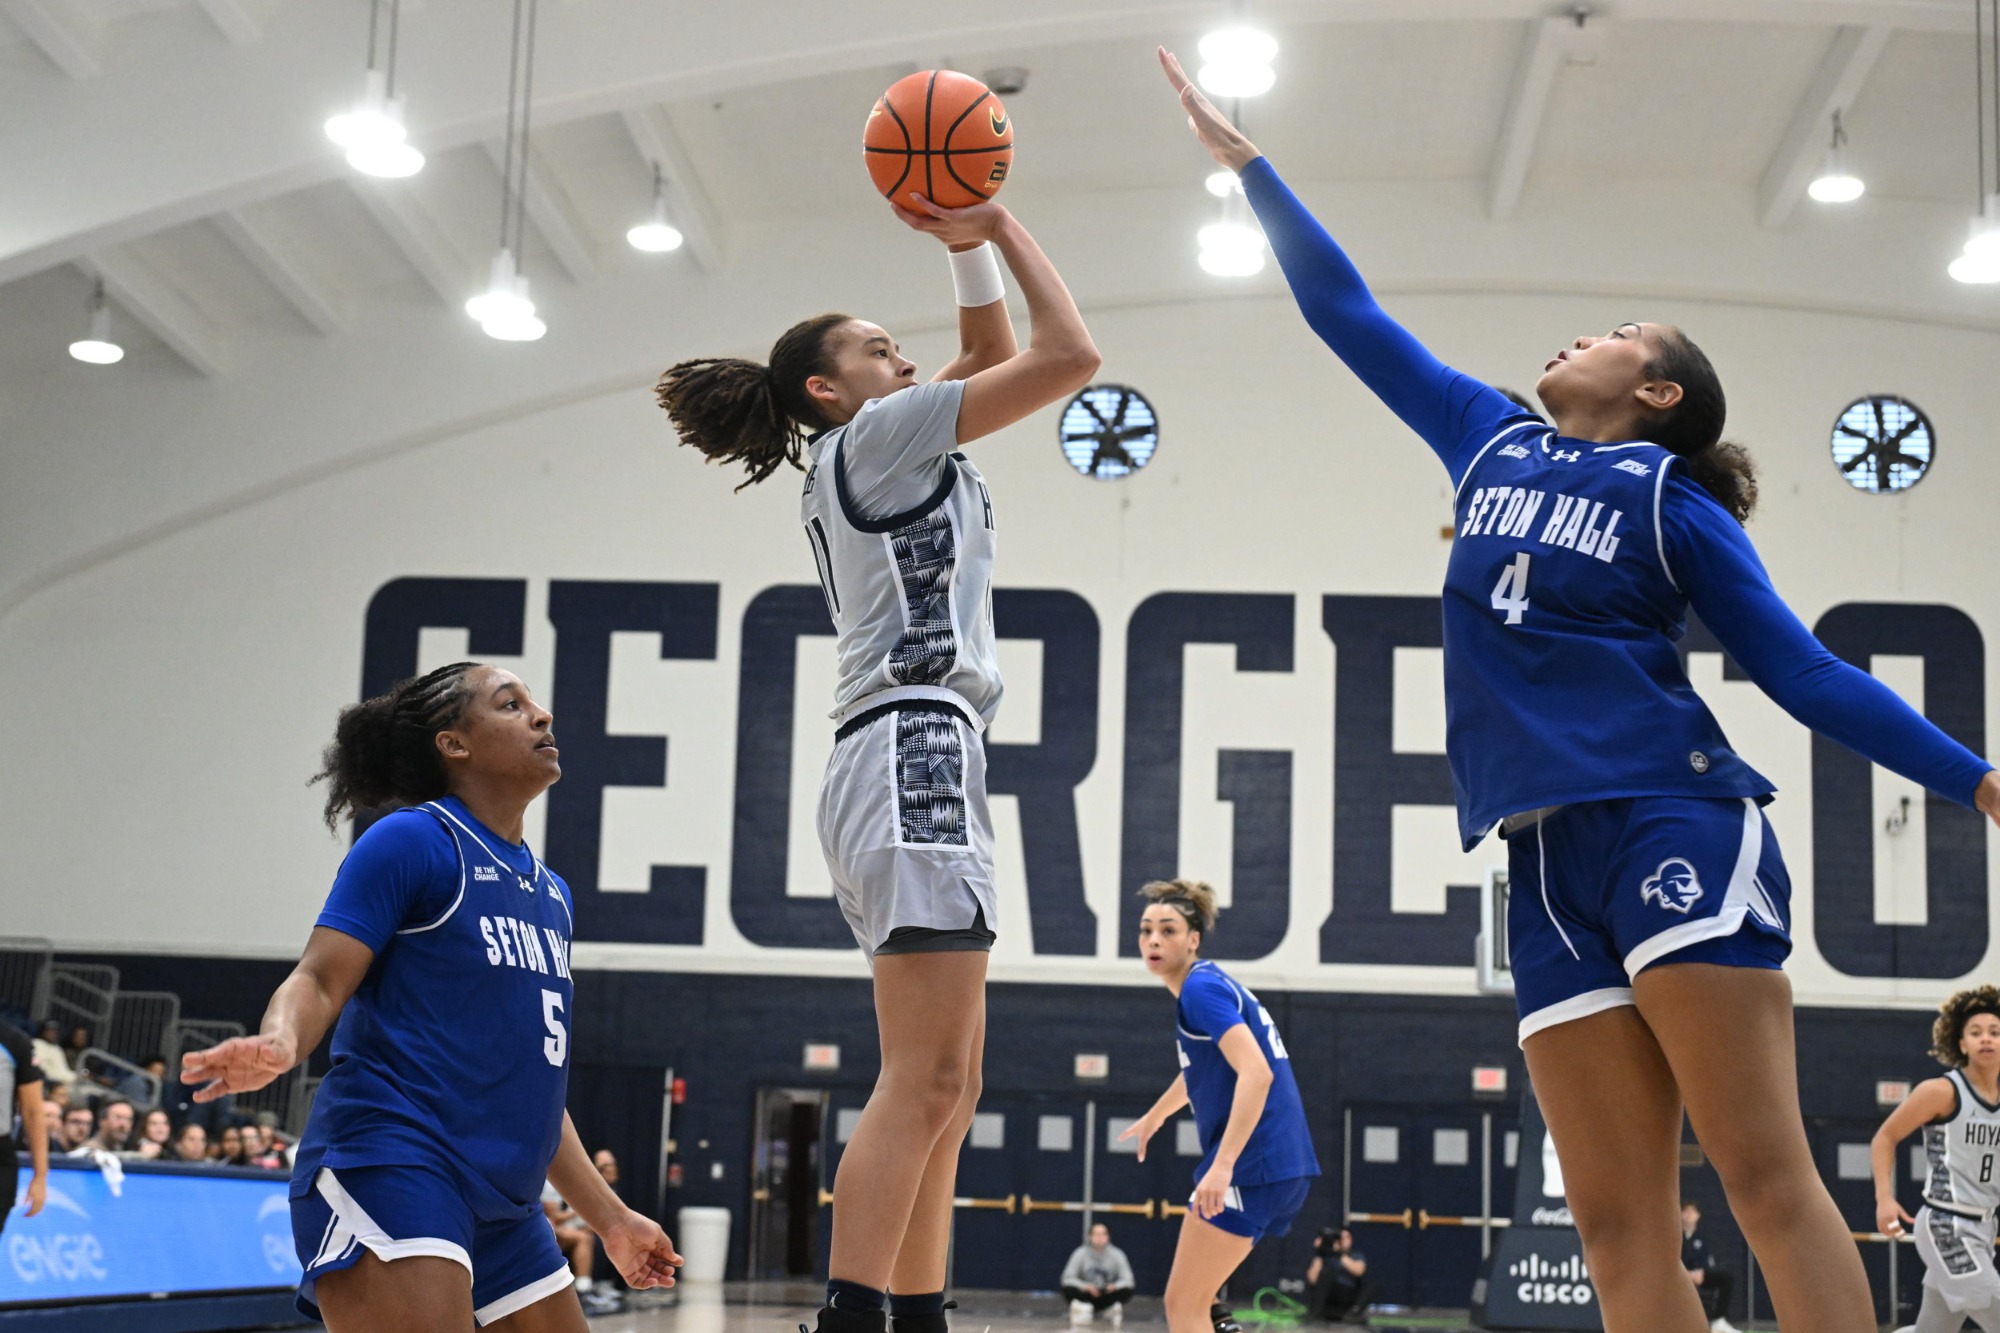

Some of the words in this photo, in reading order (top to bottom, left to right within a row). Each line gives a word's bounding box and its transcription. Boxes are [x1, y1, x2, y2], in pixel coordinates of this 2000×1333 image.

[1461, 486, 1546, 538] SETON
[1539, 493, 1624, 563] HALL
[1490, 552, 1531, 625] 4
[474, 866, 483, 874] BE
[484, 866, 496, 874] THE
[474, 873, 500, 881] CHANGE
[479, 916, 549, 975] SETON
[541, 988, 567, 1068] 5
[1979, 1153, 1994, 1183] 8
[1517, 1282, 1592, 1305] CISCO
